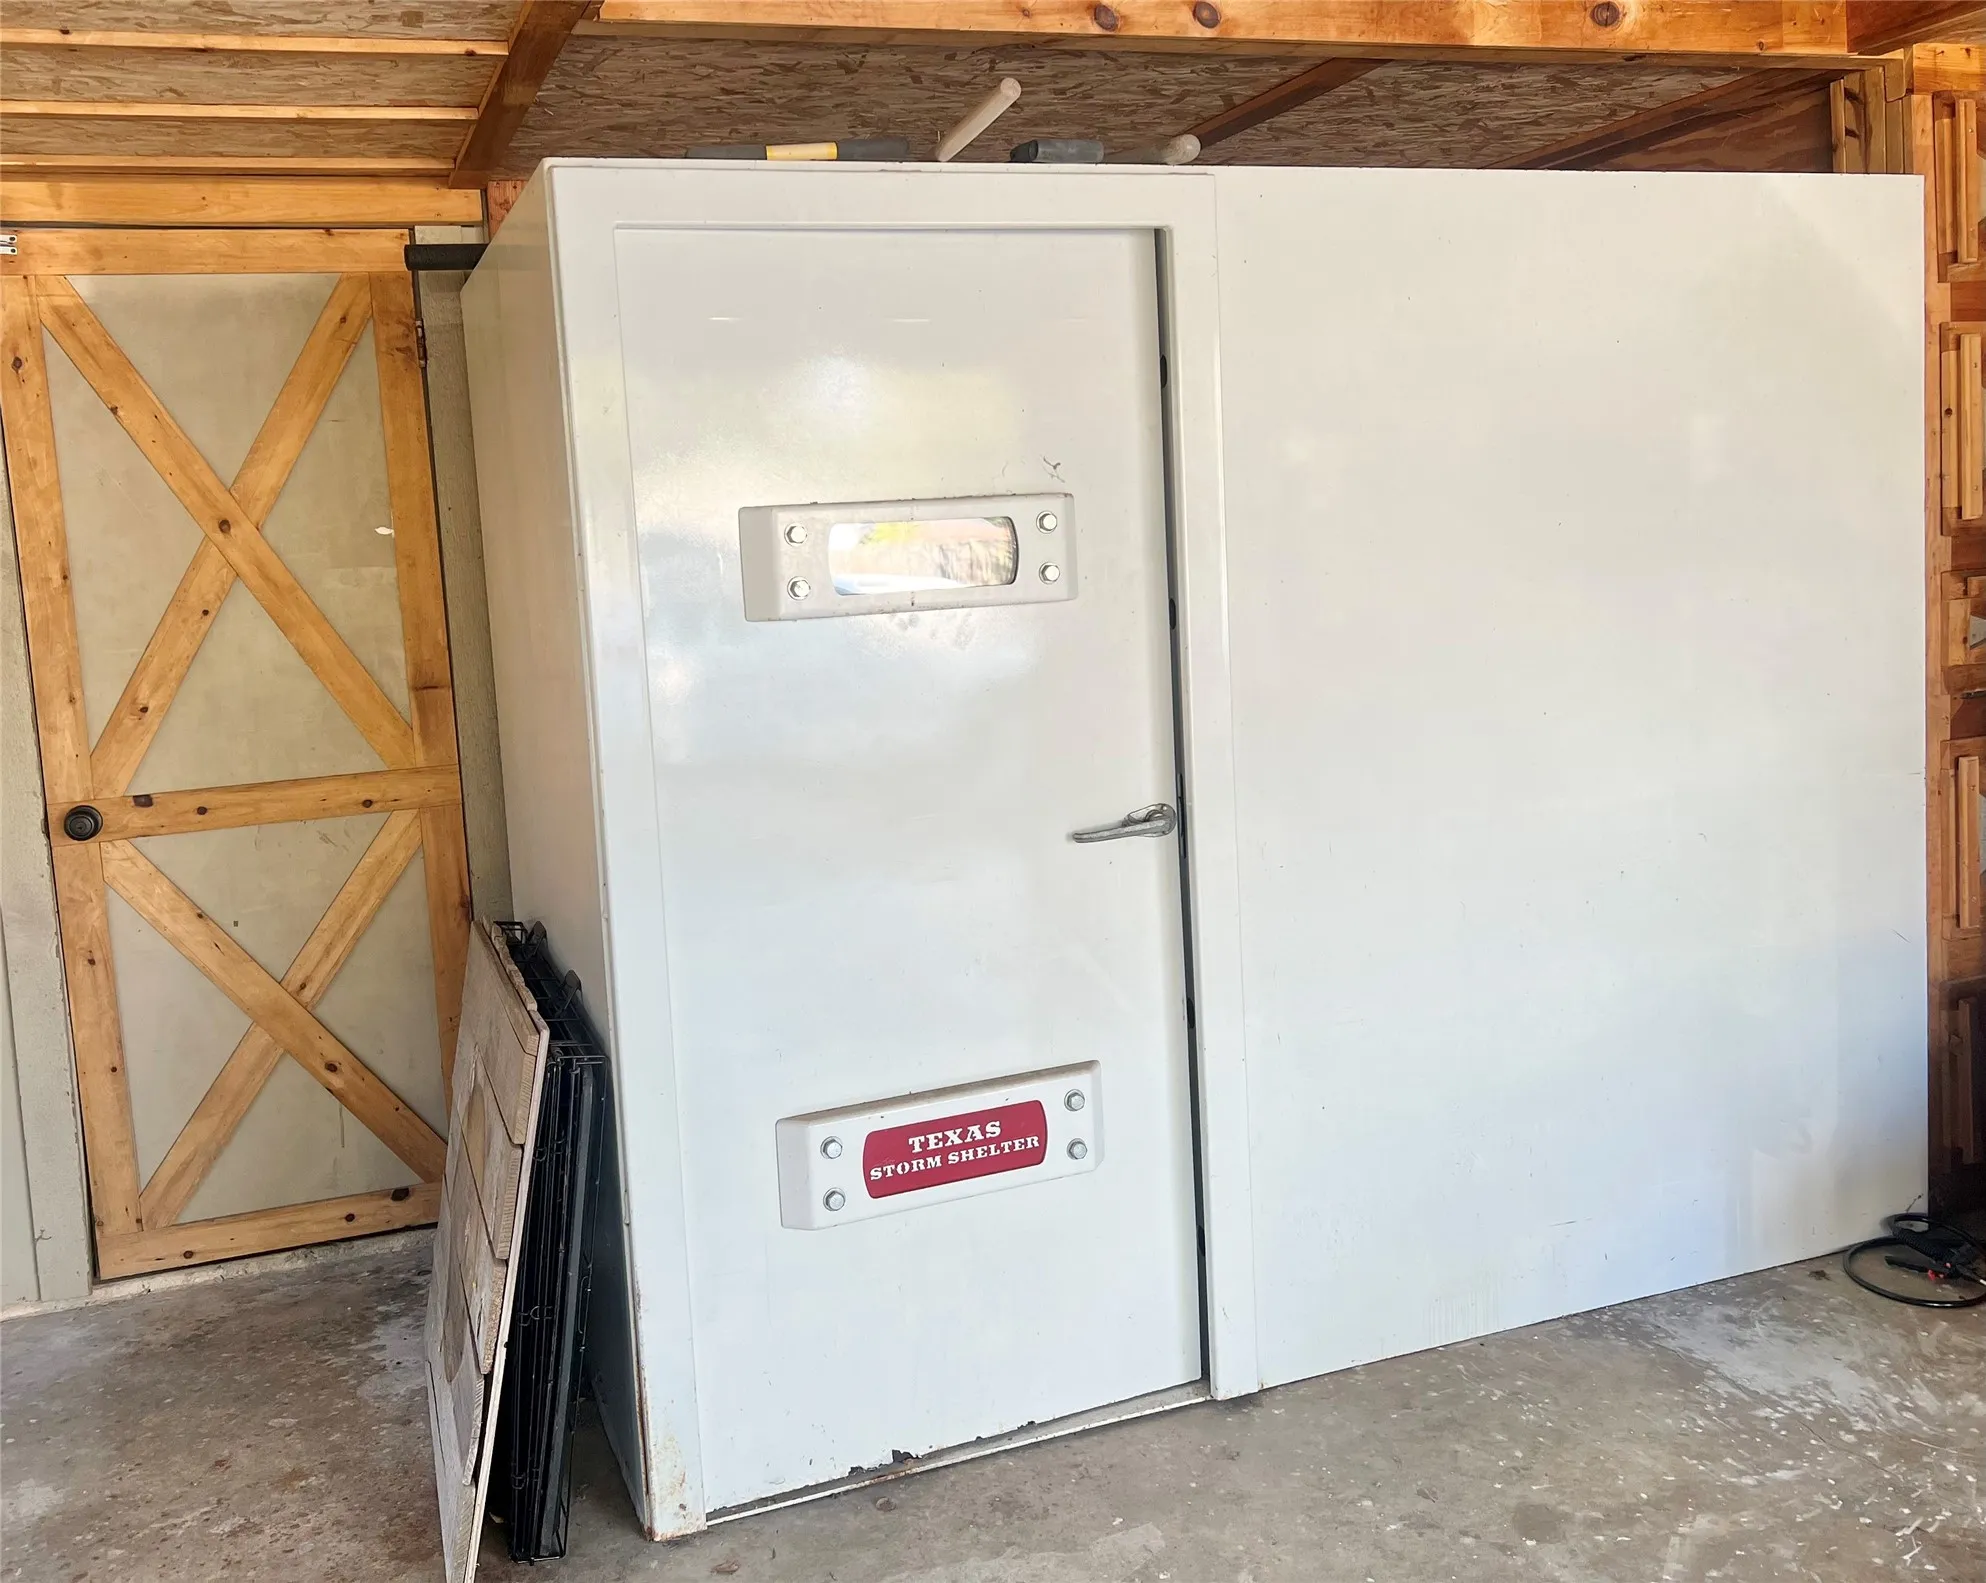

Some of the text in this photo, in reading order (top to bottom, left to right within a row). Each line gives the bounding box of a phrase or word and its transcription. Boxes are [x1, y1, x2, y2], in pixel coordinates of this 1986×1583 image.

[908, 1121, 1001, 1153] TEXAS
[870, 1135, 1039, 1181] STORM SHELTER
